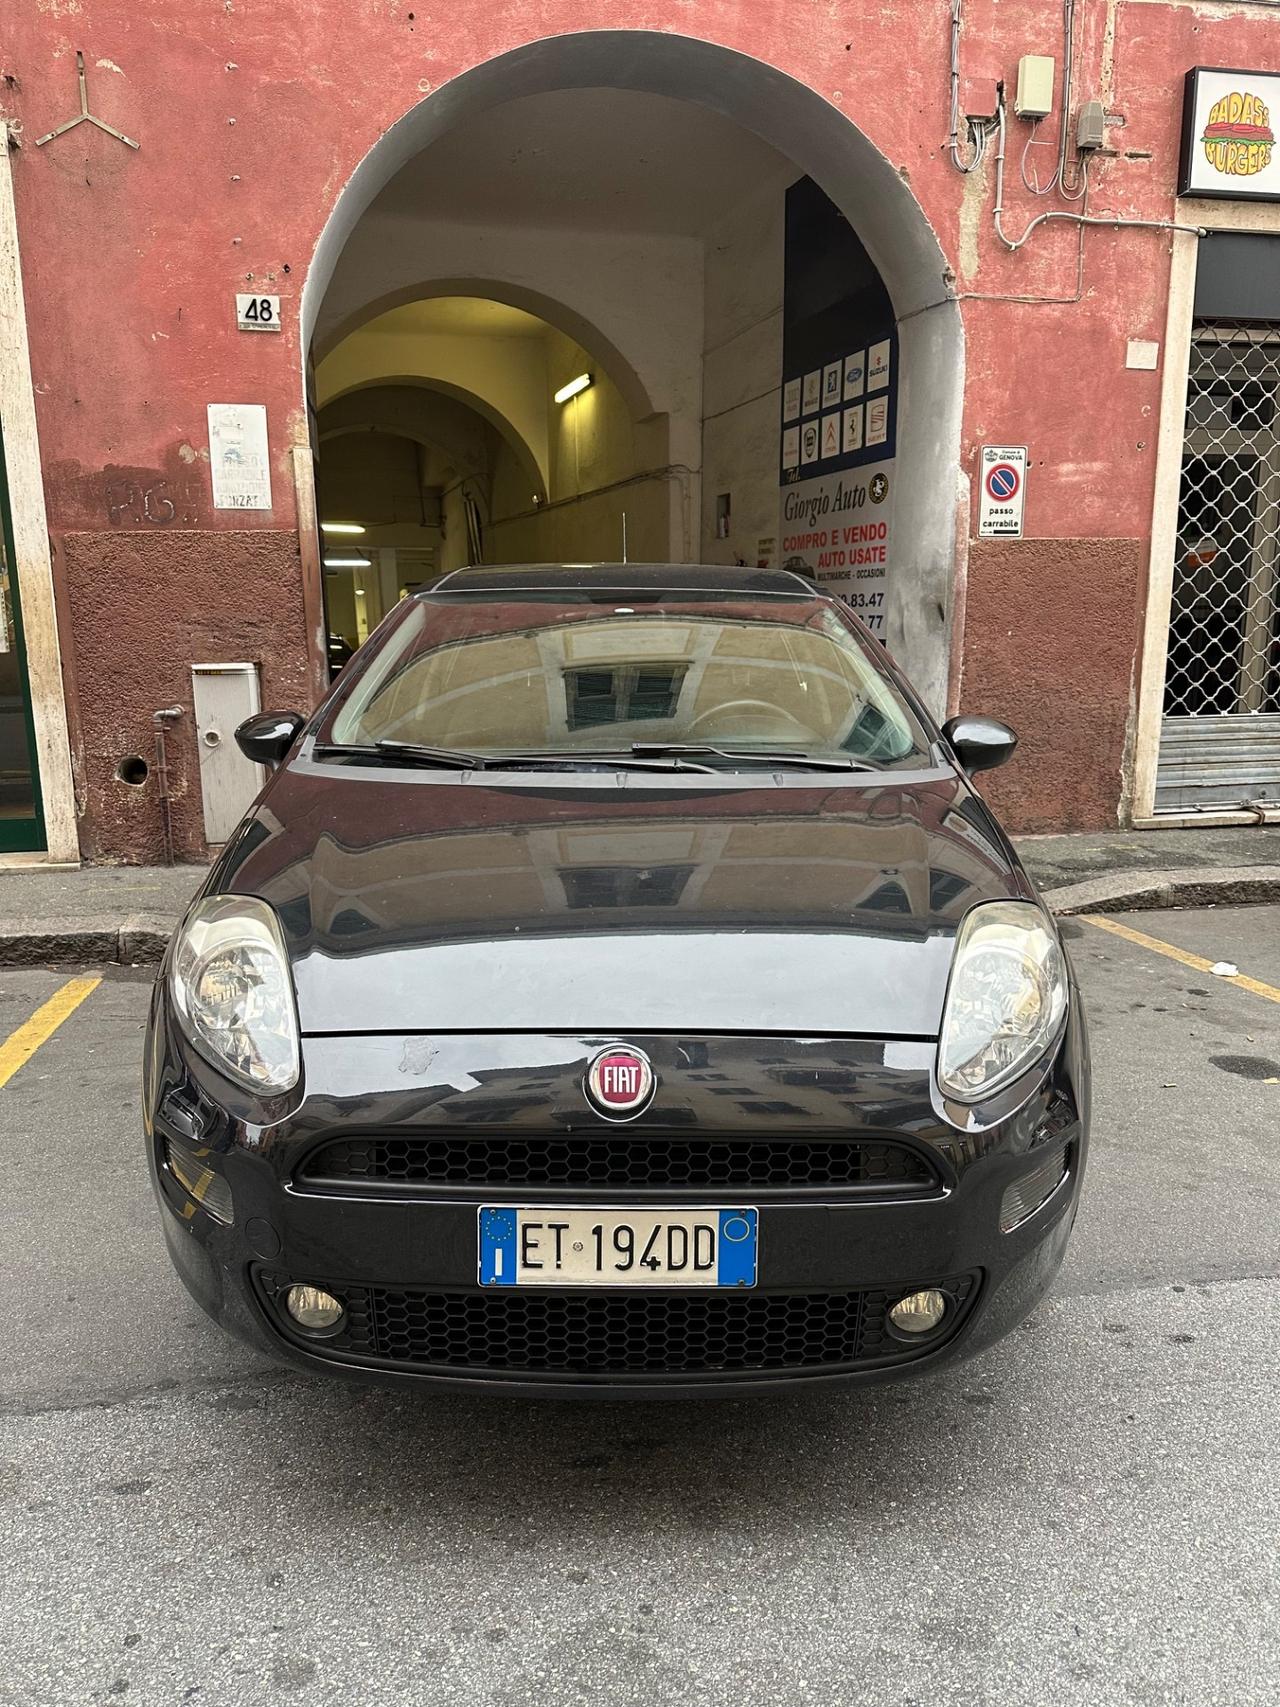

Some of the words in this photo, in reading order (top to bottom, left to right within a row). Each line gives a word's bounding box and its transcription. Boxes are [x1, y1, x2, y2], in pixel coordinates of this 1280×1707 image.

[1209, 92, 1270, 128] BADASS
[1205, 141, 1272, 176] BURGERS
[245, 298, 272, 321] 48
[869, 364, 888, 377] SUZUKI
[784, 486, 830, 527] Giorgio
[831, 481, 866, 512] Auto
[989, 508, 1014, 516] passo
[783, 531, 828, 552] COMPRO
[831, 529, 839, 546] E
[843, 522, 887, 544] VENDO
[818, 551, 846, 568] AUTO
[849, 545, 887, 565] USATE
[856, 567, 886, 579] OCCASIONI
[604, 1066, 639, 1093] FIAT
[521, 1223, 570, 1269] ET
[592, 1224, 715, 1271] 194DD
